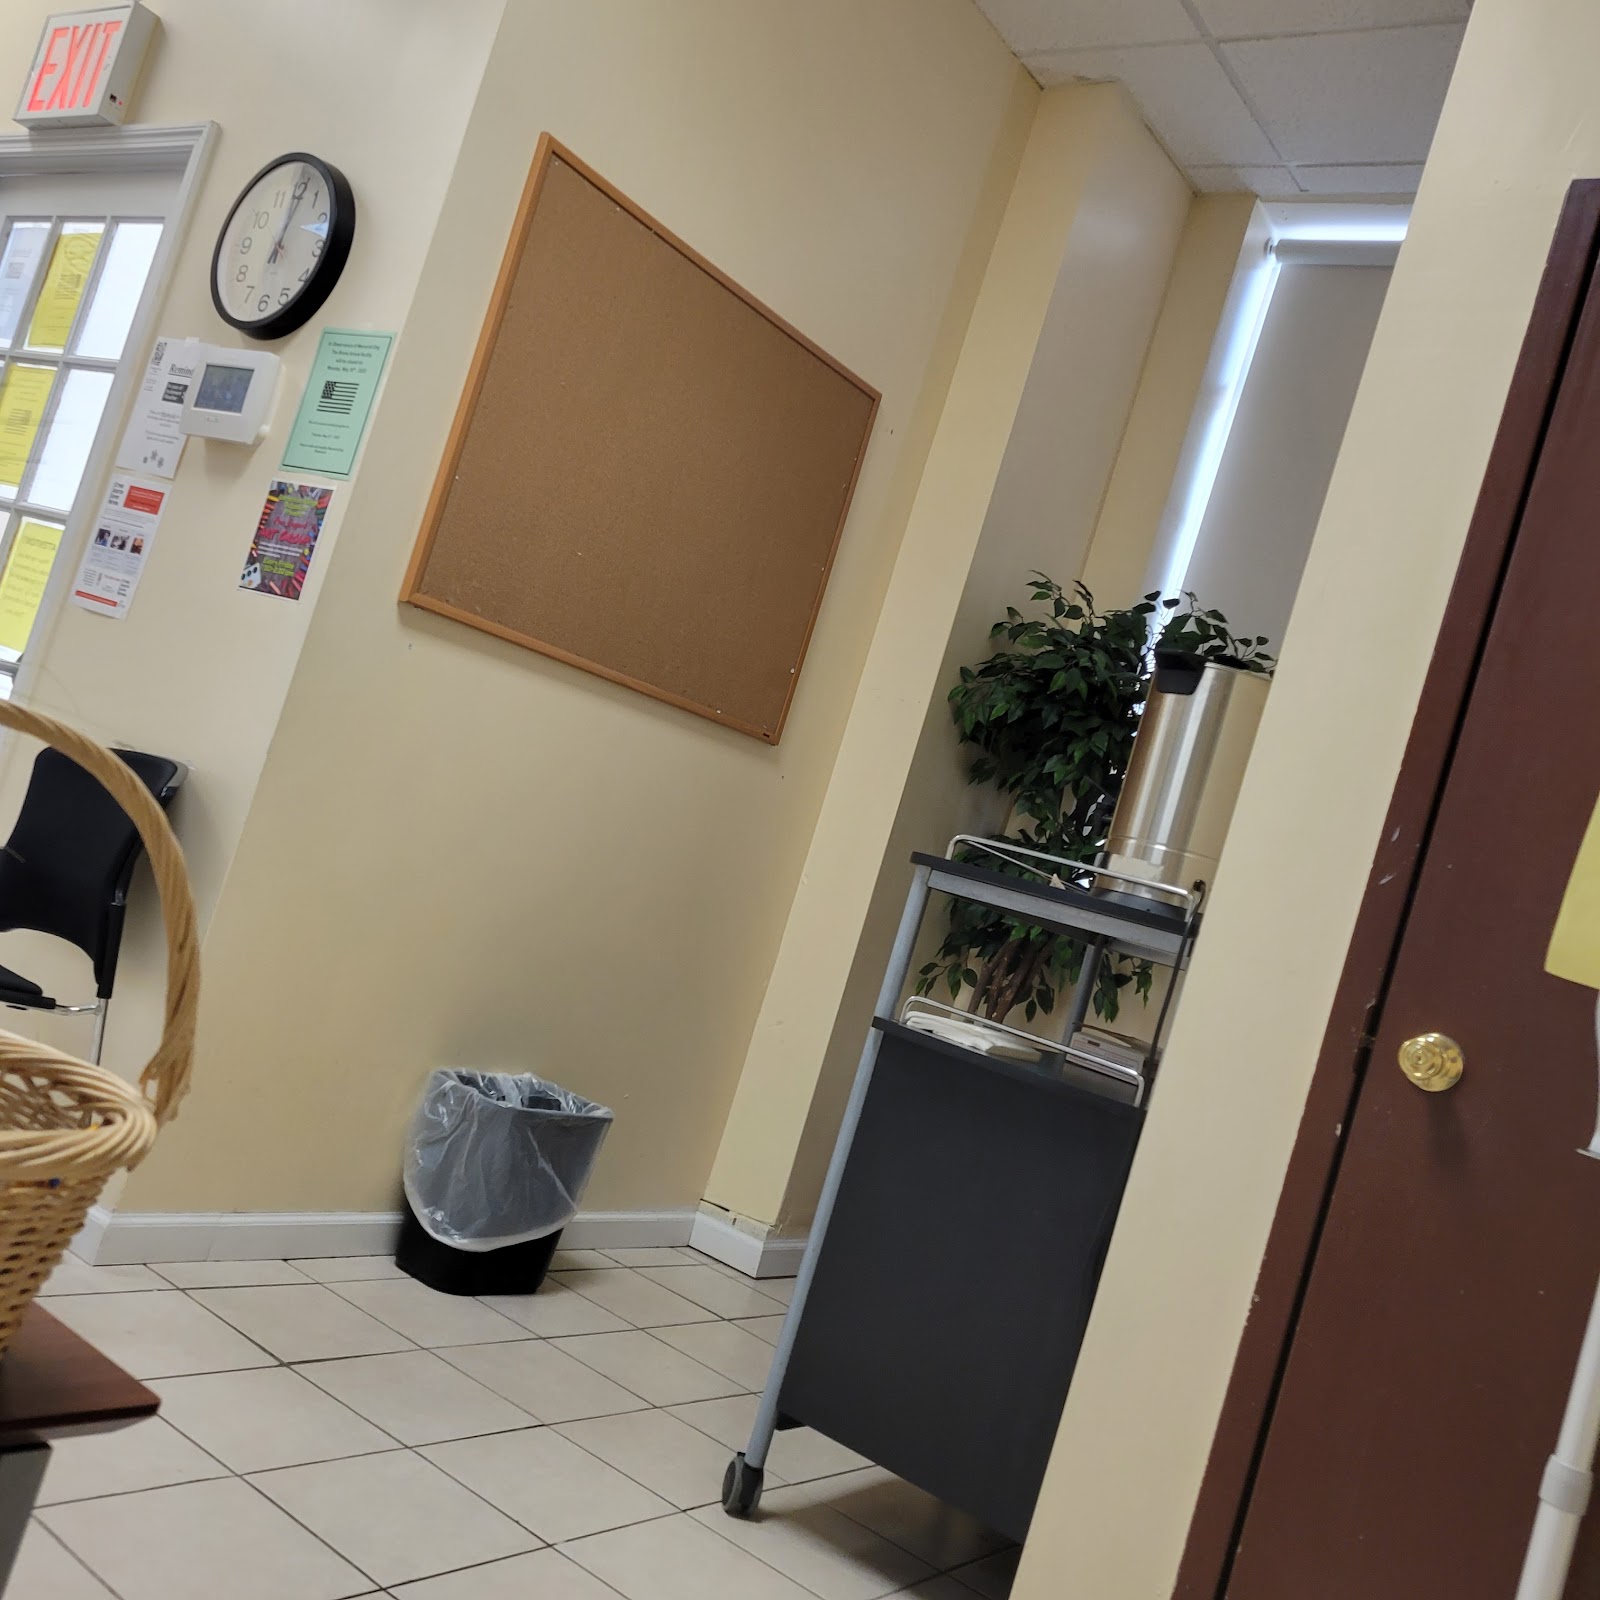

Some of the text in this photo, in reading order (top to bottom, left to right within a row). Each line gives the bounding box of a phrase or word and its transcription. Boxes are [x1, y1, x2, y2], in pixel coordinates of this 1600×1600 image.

[27, 20, 122, 111] EXIT
[273, 190, 286, 208] 11
[293, 181, 307, 200] 12
[312, 190, 319, 209] 1
[253, 211, 269, 229] 10
[317, 212, 328, 231] 2
[240, 237, 252, 254] 9
[312, 239, 324, 257] 3
[236, 265, 248, 282] 8
[298, 268, 310, 283] 4
[244, 286, 254, 303] 7
[258, 295, 270, 312] 6
[278, 287, 290, 305] 5
